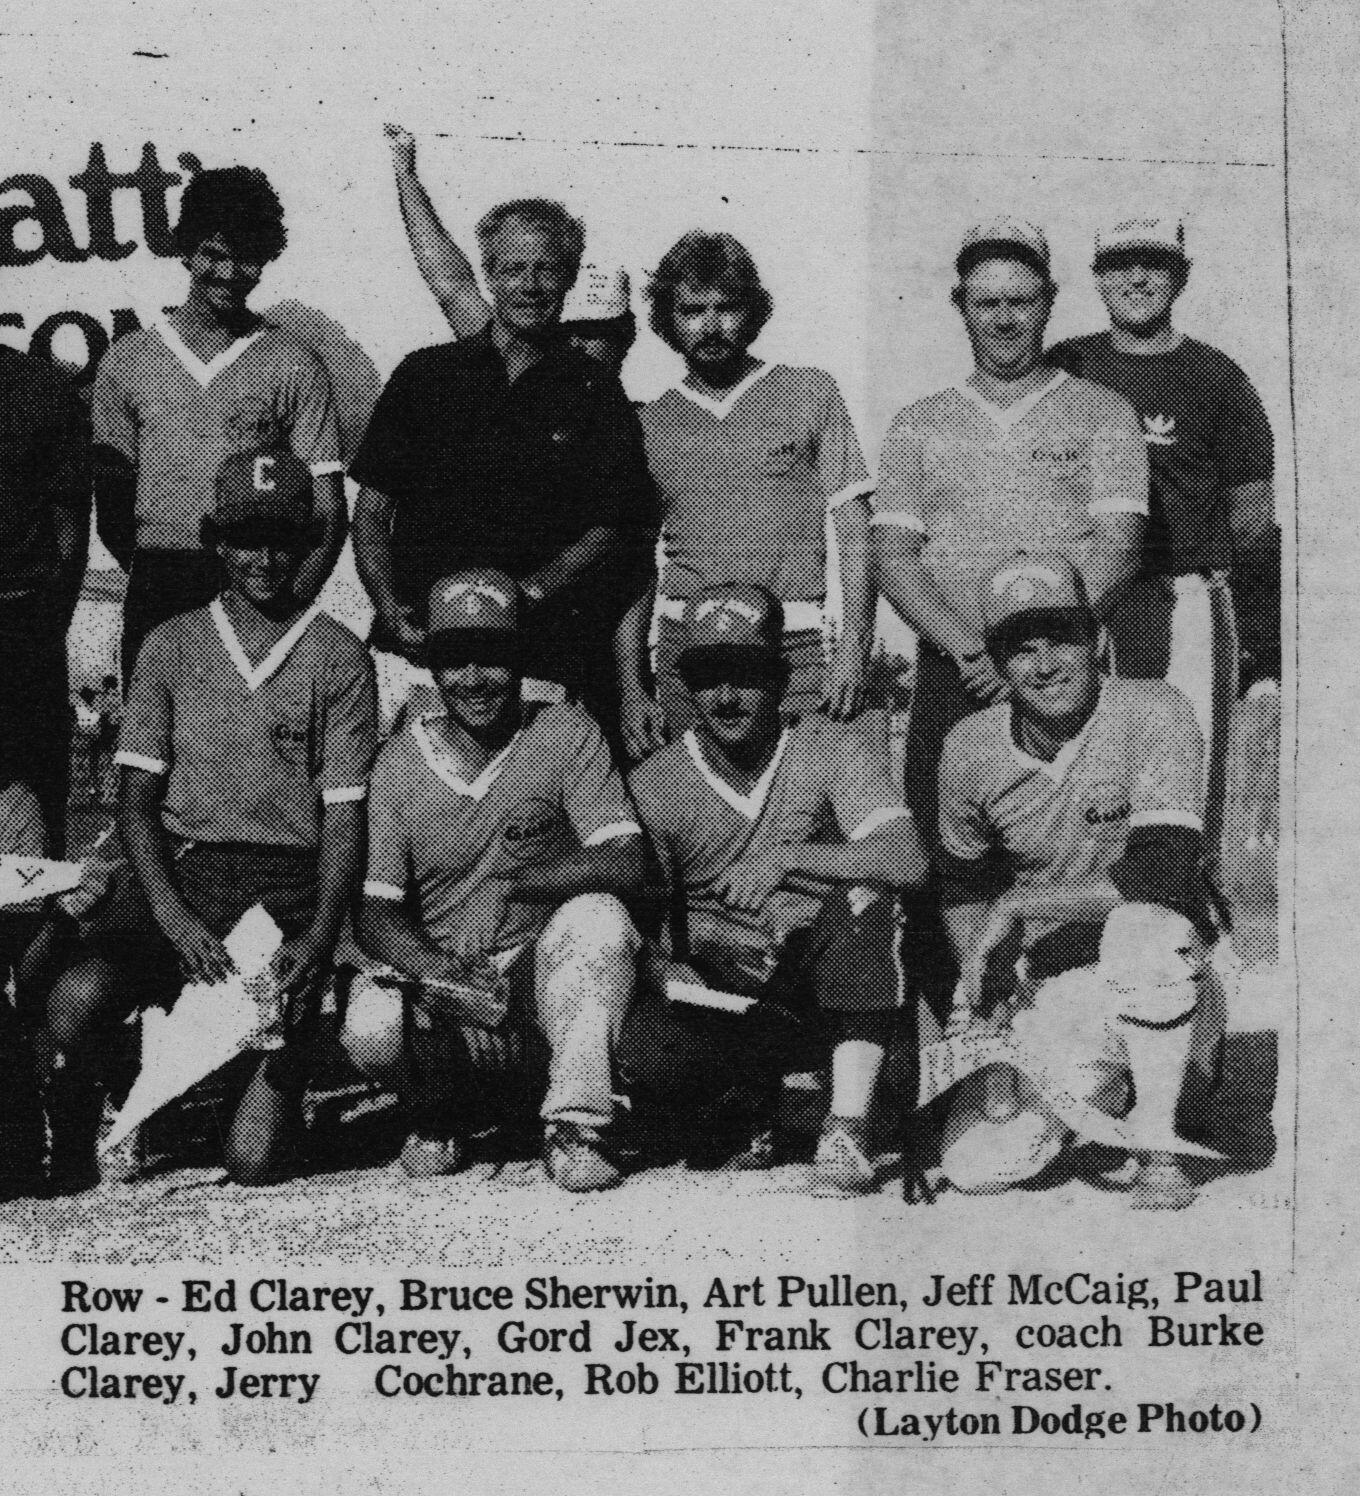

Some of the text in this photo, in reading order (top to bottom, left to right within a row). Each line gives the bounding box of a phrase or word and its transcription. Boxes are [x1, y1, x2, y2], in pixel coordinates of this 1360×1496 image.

[253, 456, 276, 491] C
[61, 1269, 1264, 1318] Row - Ed Clarey, Bruce Sherwin, Art Pullen, Jeff McCaig, Paul
[60, 1313, 1264, 1362] Clarey, John Clarey, Gord Jex, Frank Clarey, coach Burke
[60, 1360, 1112, 1406] Clarey, Jerry Cochrane, Rob Elliott, Charlie Fraser.
[857, 1402, 1262, 1441] (Layton Dodge Photo)
